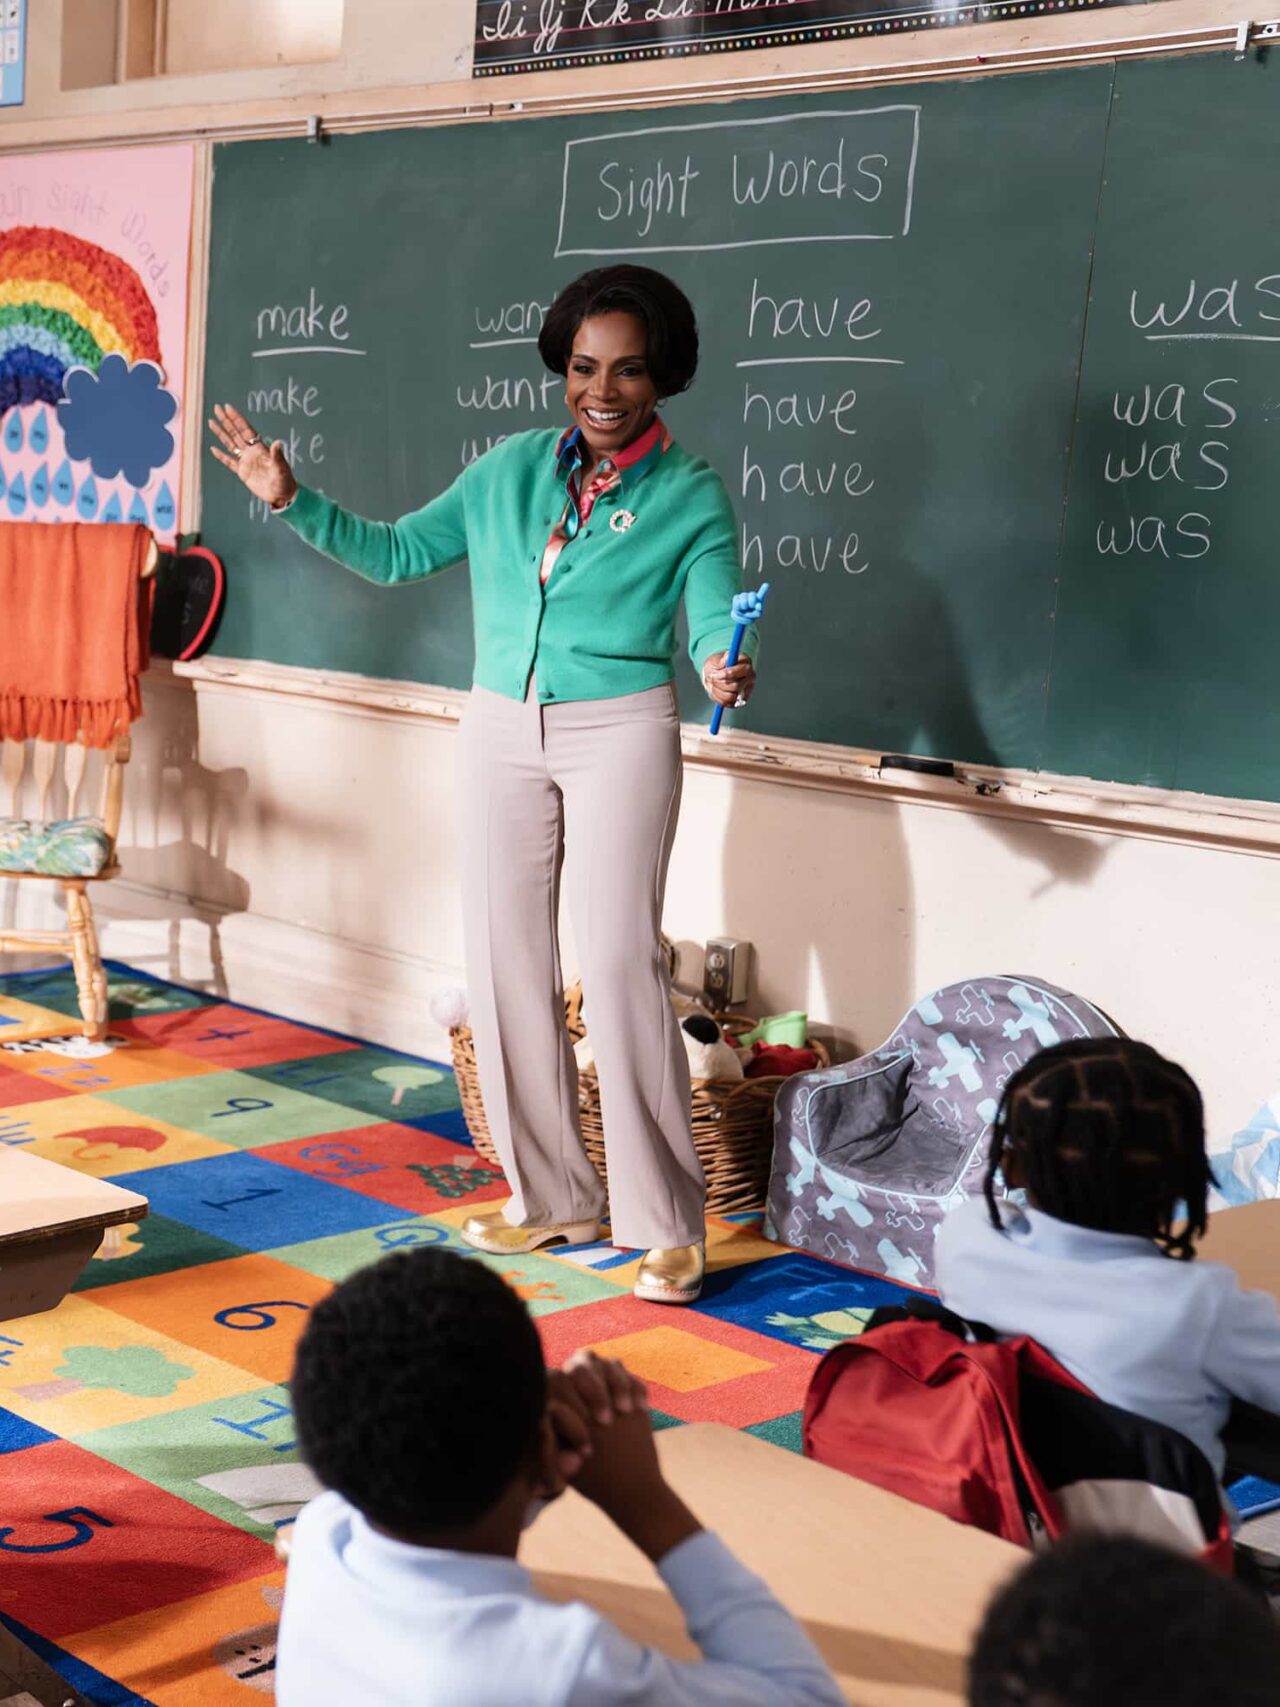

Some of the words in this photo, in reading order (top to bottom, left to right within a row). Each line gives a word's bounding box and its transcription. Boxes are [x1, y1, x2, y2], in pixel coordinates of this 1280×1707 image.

[598, 155, 700, 237] Sight
[733, 138, 888, 204] Words
[257, 288, 350, 342] make
[749, 278, 882, 340] have
[1129, 273, 1280, 328] was
[247, 376, 323, 417] make
[456, 373, 561, 413] want
[743, 382, 857, 434] have
[1113, 378, 1238, 428] was
[741, 445, 874, 501] have
[1104, 440, 1230, 490] was
[741, 521, 869, 574] have
[1097, 512, 1211, 558] was
[211, 1097, 274, 1118] 9
[298, 1144, 388, 1178] Gg
[214, 1301, 310, 1331] 6
